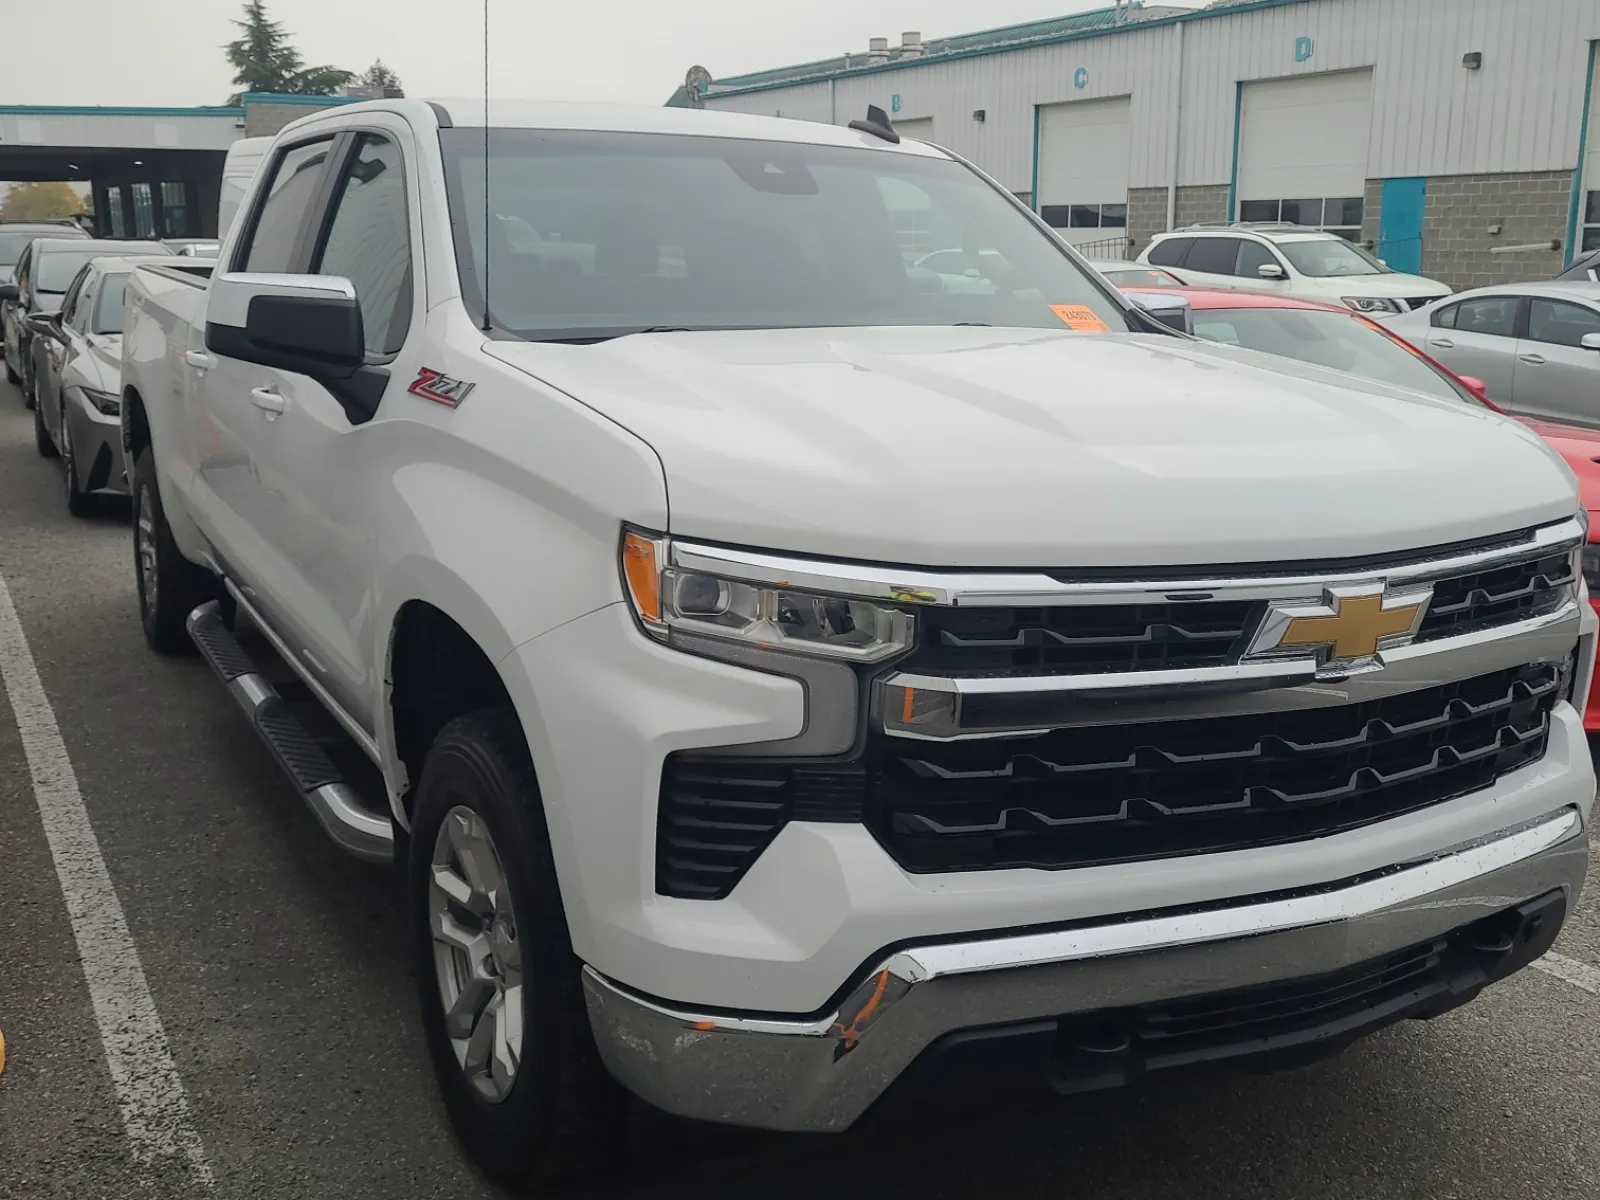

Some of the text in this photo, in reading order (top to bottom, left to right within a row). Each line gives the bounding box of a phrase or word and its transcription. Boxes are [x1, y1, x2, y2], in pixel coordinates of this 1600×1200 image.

[1295, 36, 1312, 62] D
[1074, 67, 1087, 89] C
[892, 94, 901, 112] B
[407, 366, 476, 409] Z71
